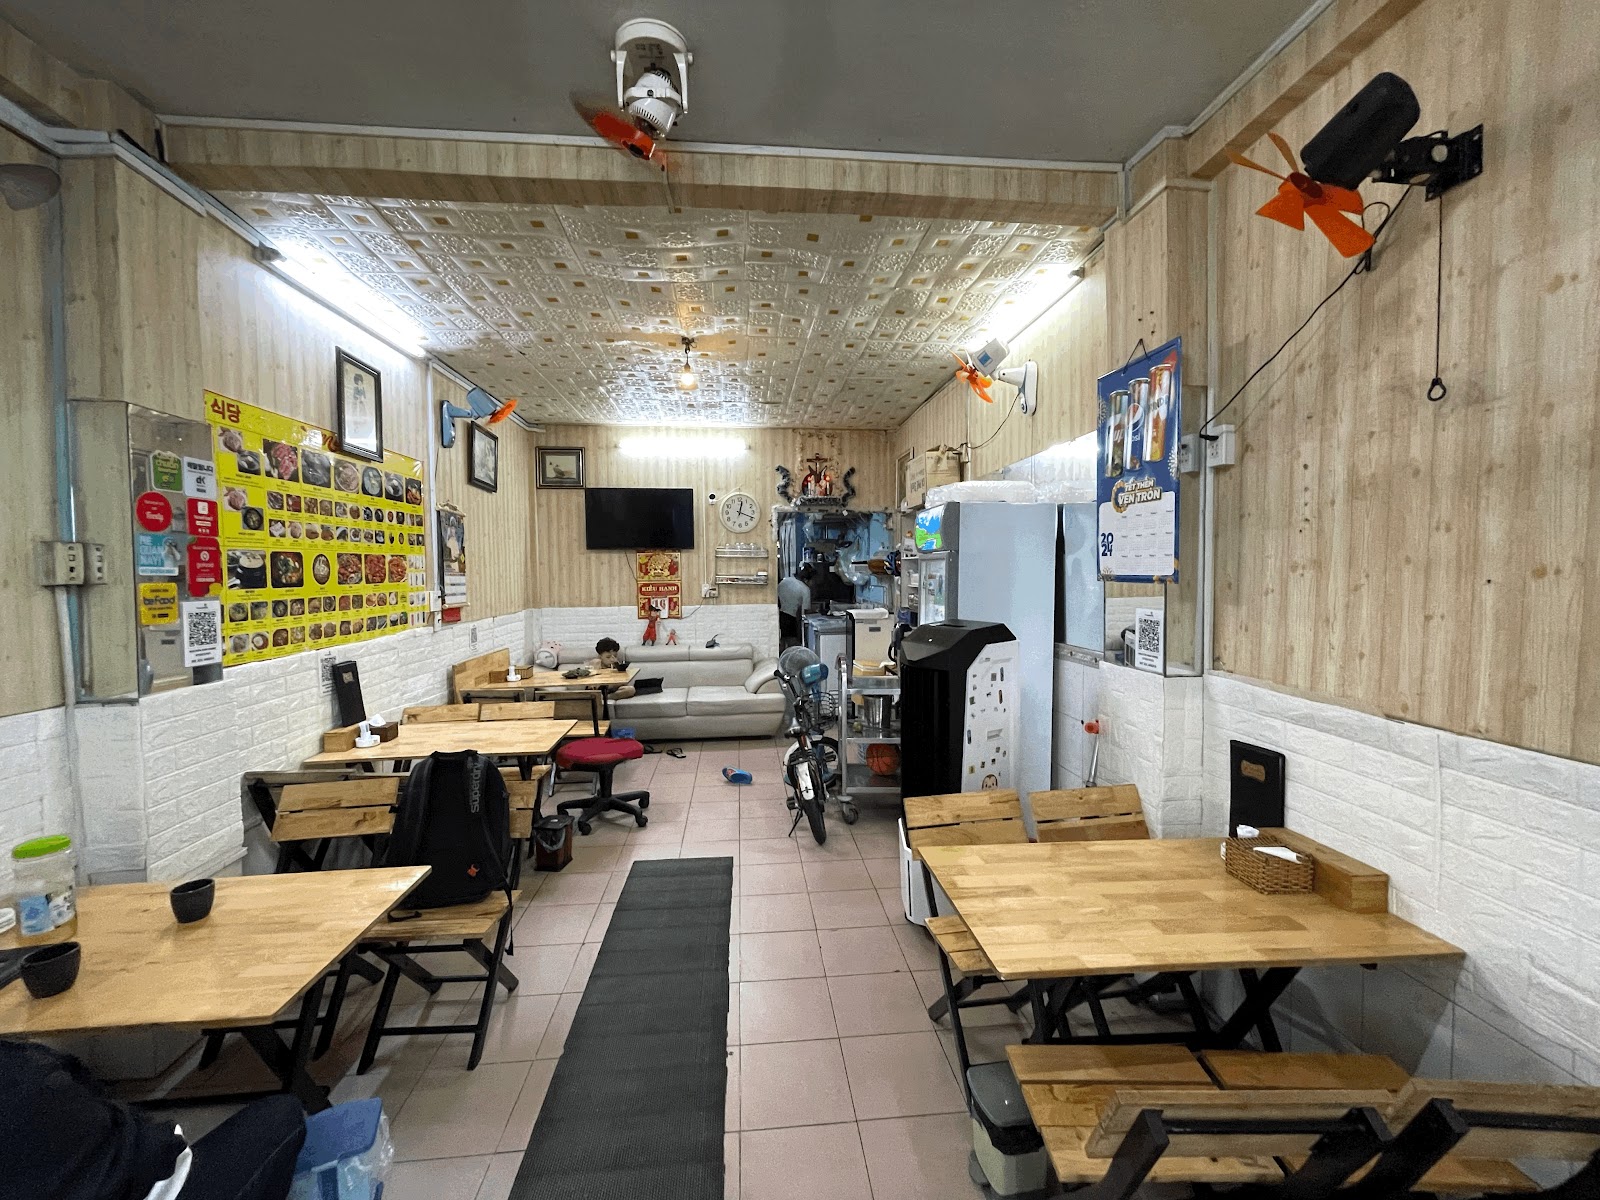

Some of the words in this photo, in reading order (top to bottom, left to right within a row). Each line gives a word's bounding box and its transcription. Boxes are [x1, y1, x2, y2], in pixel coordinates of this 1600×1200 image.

[211, 398, 241, 423] 식당
[1101, 532, 1114, 544] 20
[1101, 543, 1113, 556] 24
